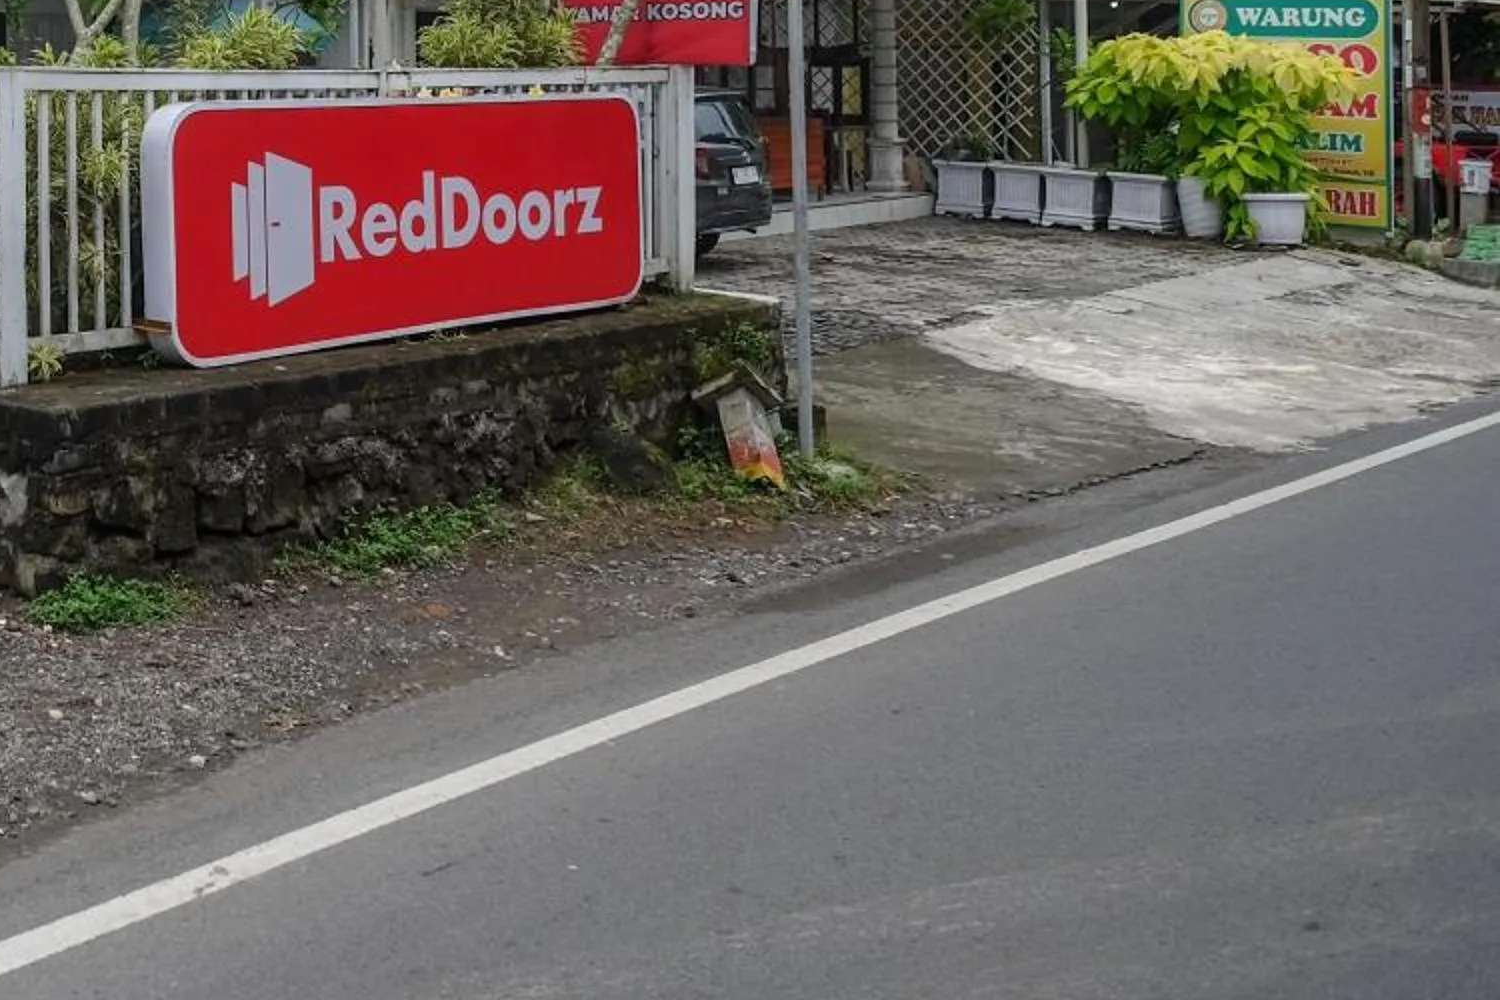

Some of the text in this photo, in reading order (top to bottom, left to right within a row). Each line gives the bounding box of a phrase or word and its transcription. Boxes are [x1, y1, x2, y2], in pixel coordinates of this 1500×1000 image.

[647, 1, 744, 21] KOSONG
[1235, 6, 1367, 28] WARUNG
[319, 169, 604, 263] RedDoorz
